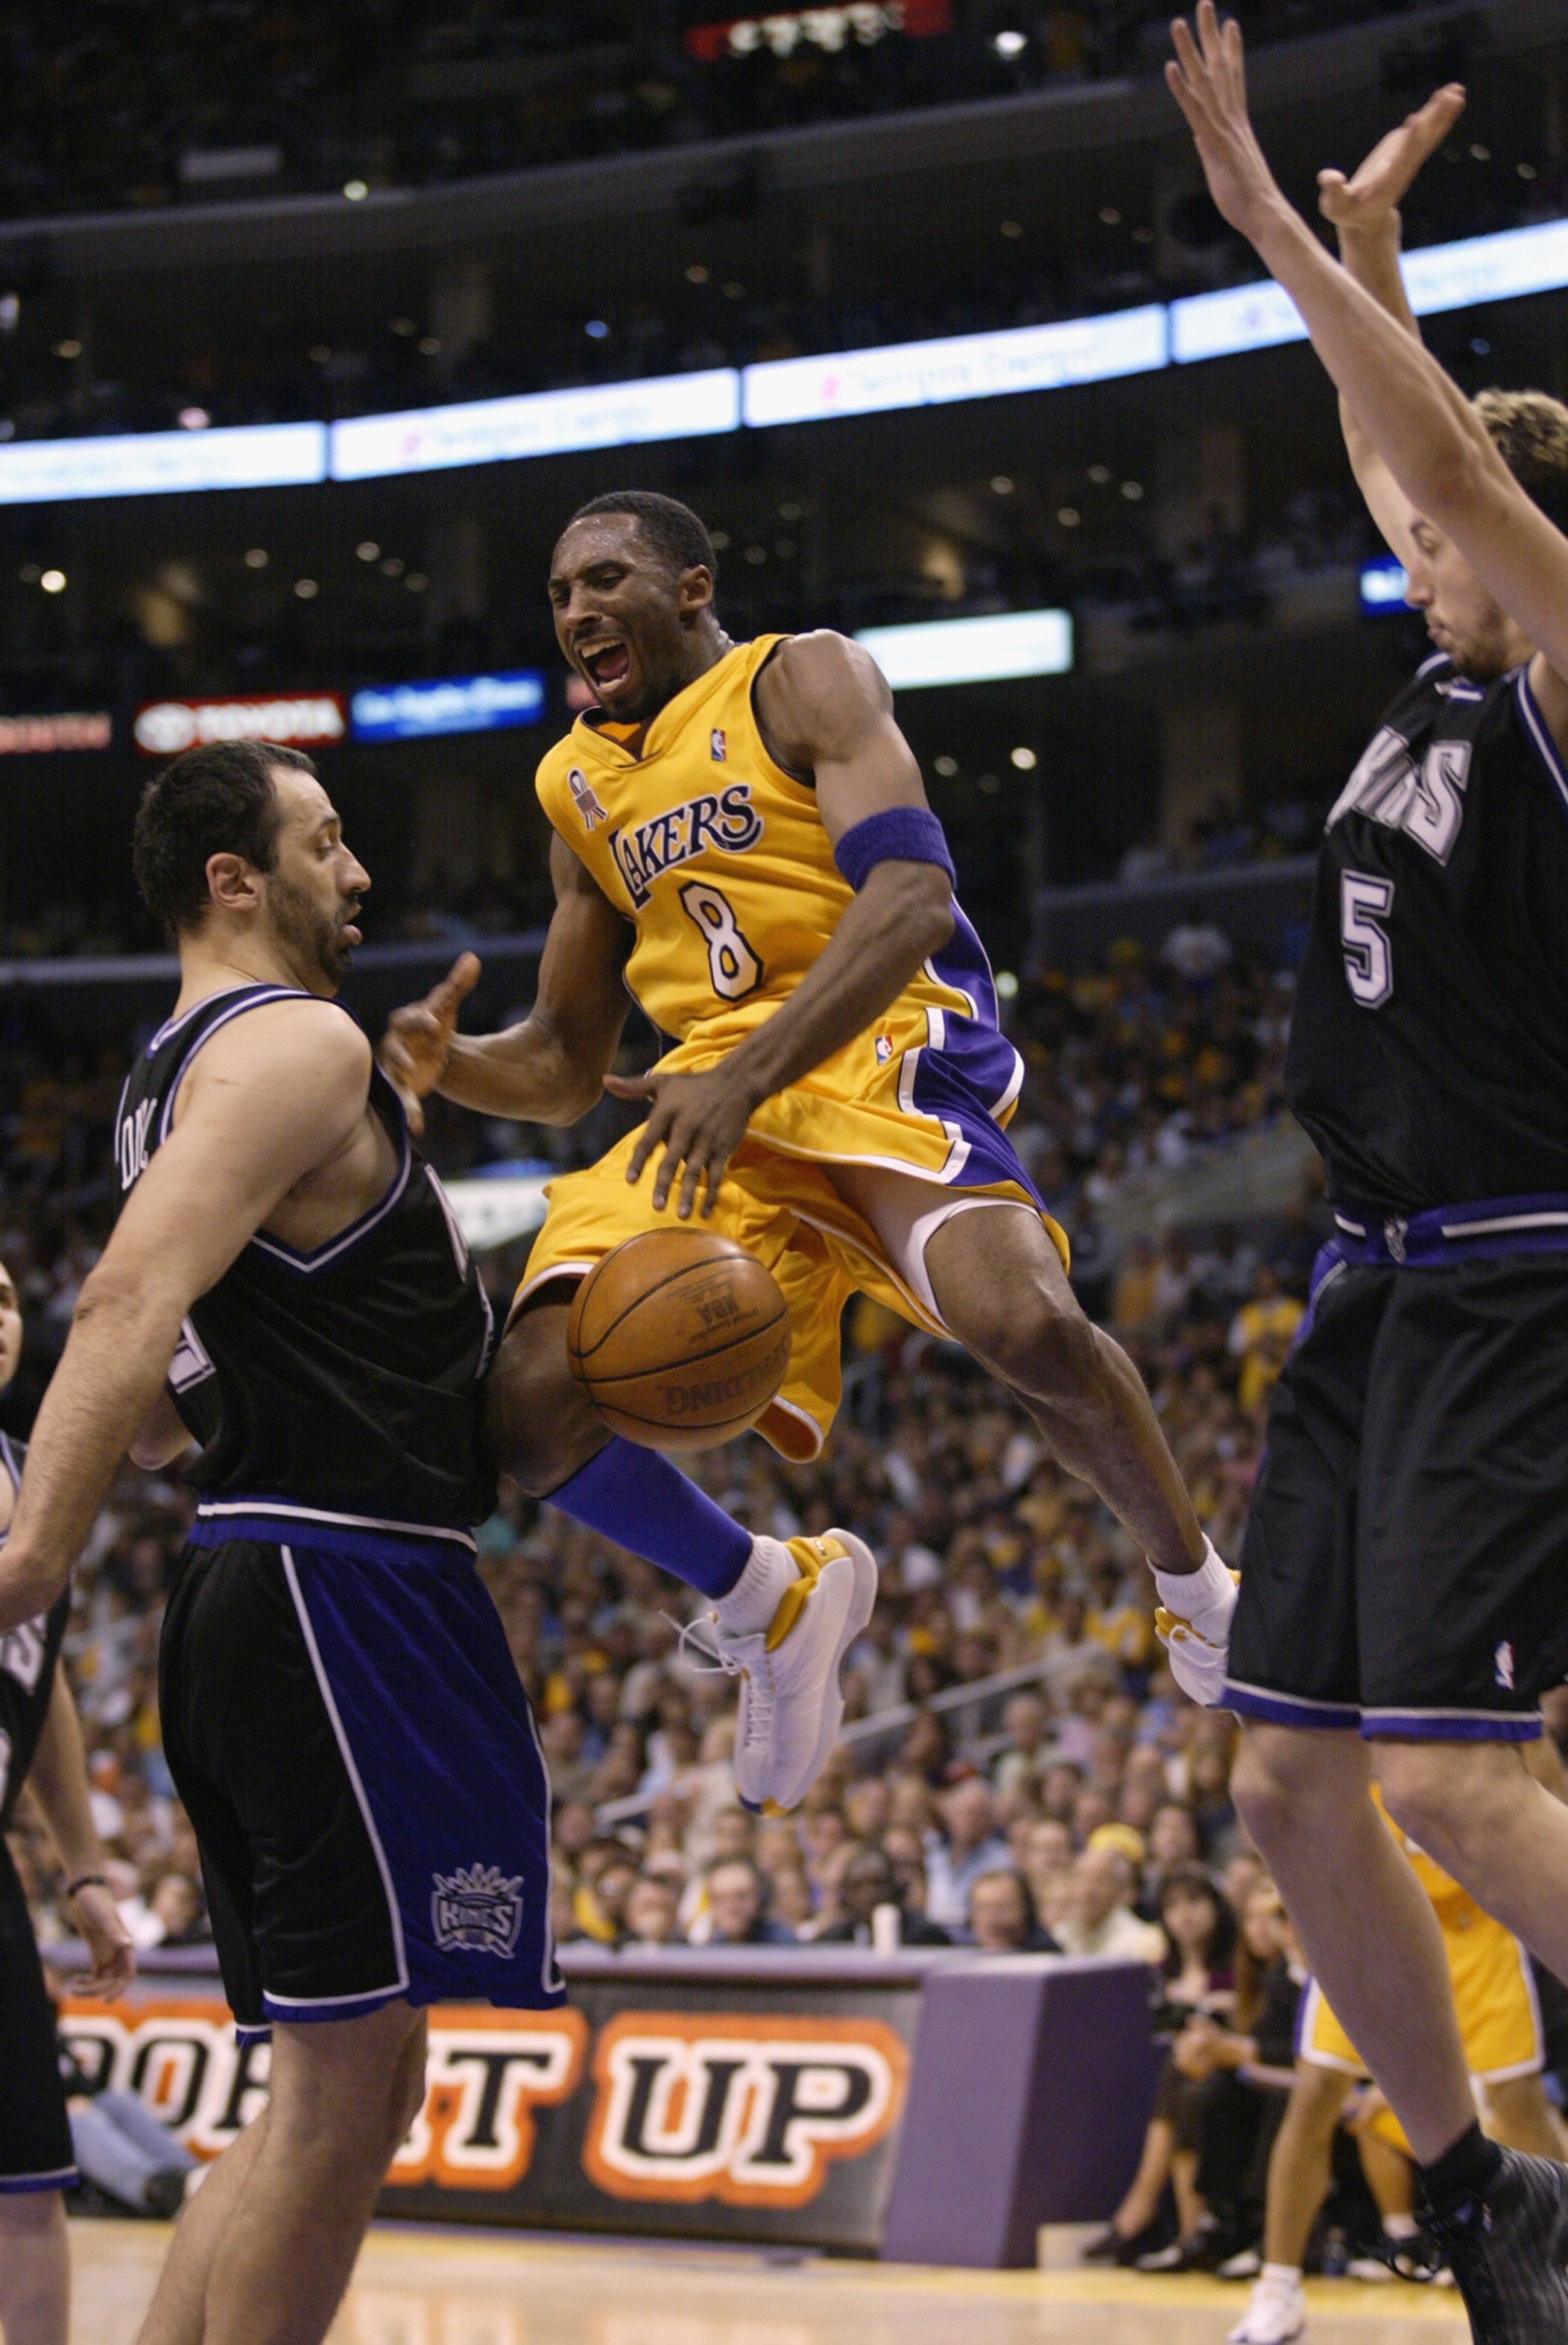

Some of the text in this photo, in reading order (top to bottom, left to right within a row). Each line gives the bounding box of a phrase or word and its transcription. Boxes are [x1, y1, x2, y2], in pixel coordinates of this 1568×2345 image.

[607, 783, 765, 912] LAKERS
[677, 880, 764, 1003] 8
[1341, 868, 1394, 1010] 5
[395, 2031, 570, 2168] T
[600, 2036, 891, 2185] UP
